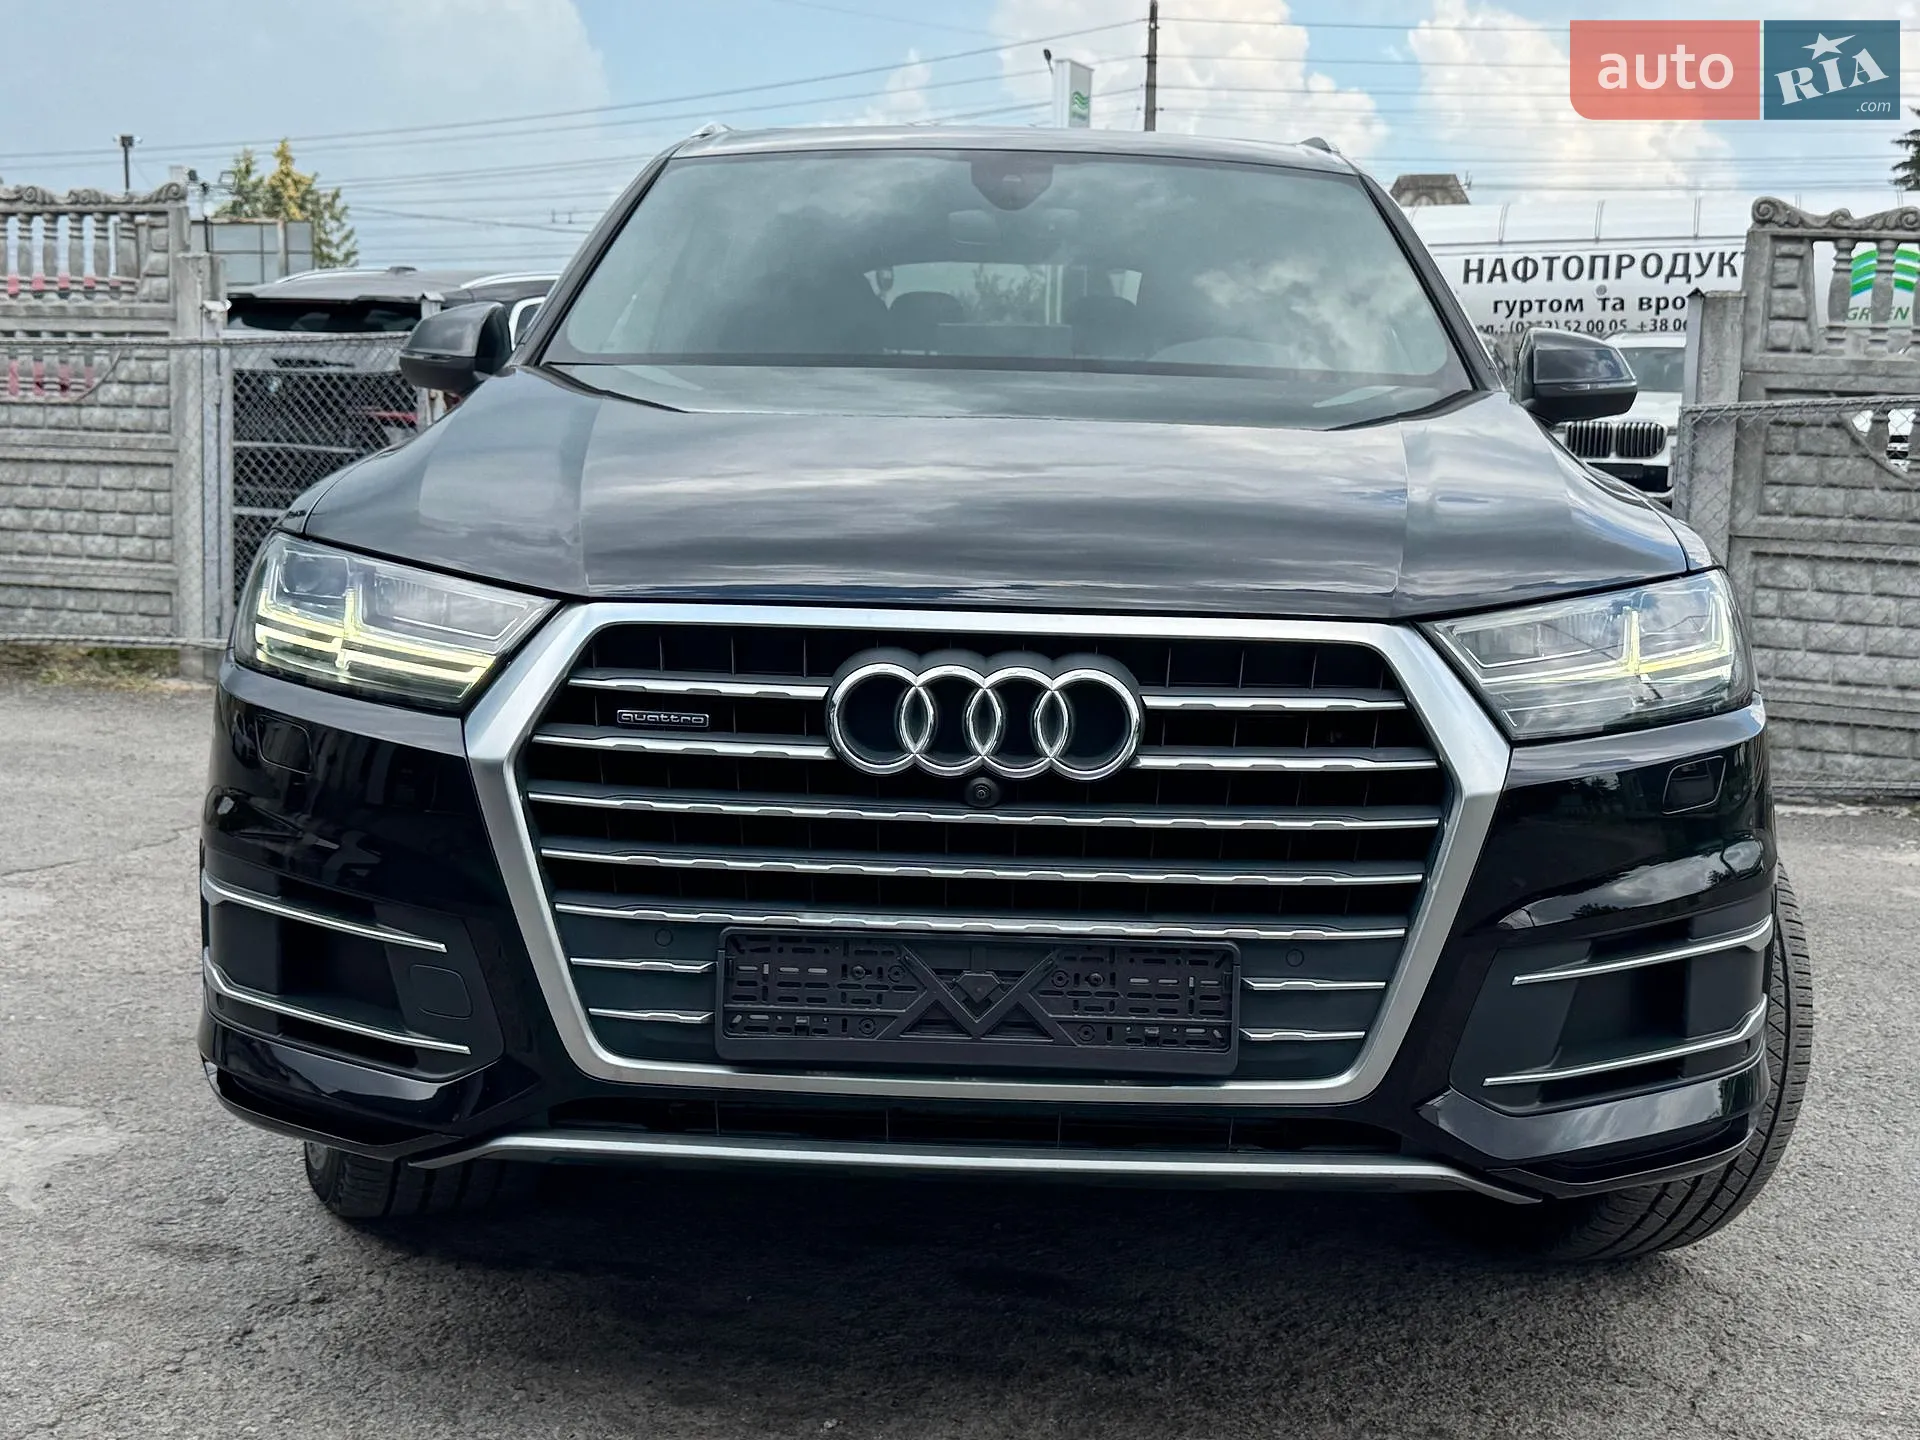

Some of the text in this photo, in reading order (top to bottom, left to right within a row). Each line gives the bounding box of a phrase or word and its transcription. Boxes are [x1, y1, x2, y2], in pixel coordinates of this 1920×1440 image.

[1462, 251, 1744, 285] НАФТОПРОДУК
[1493, 295, 1689, 318] гуртом та вро
[1586, 319, 1604, 333] 00
[1637, 318, 1668, 332] +38
[621, 712, 704, 724] quattro
